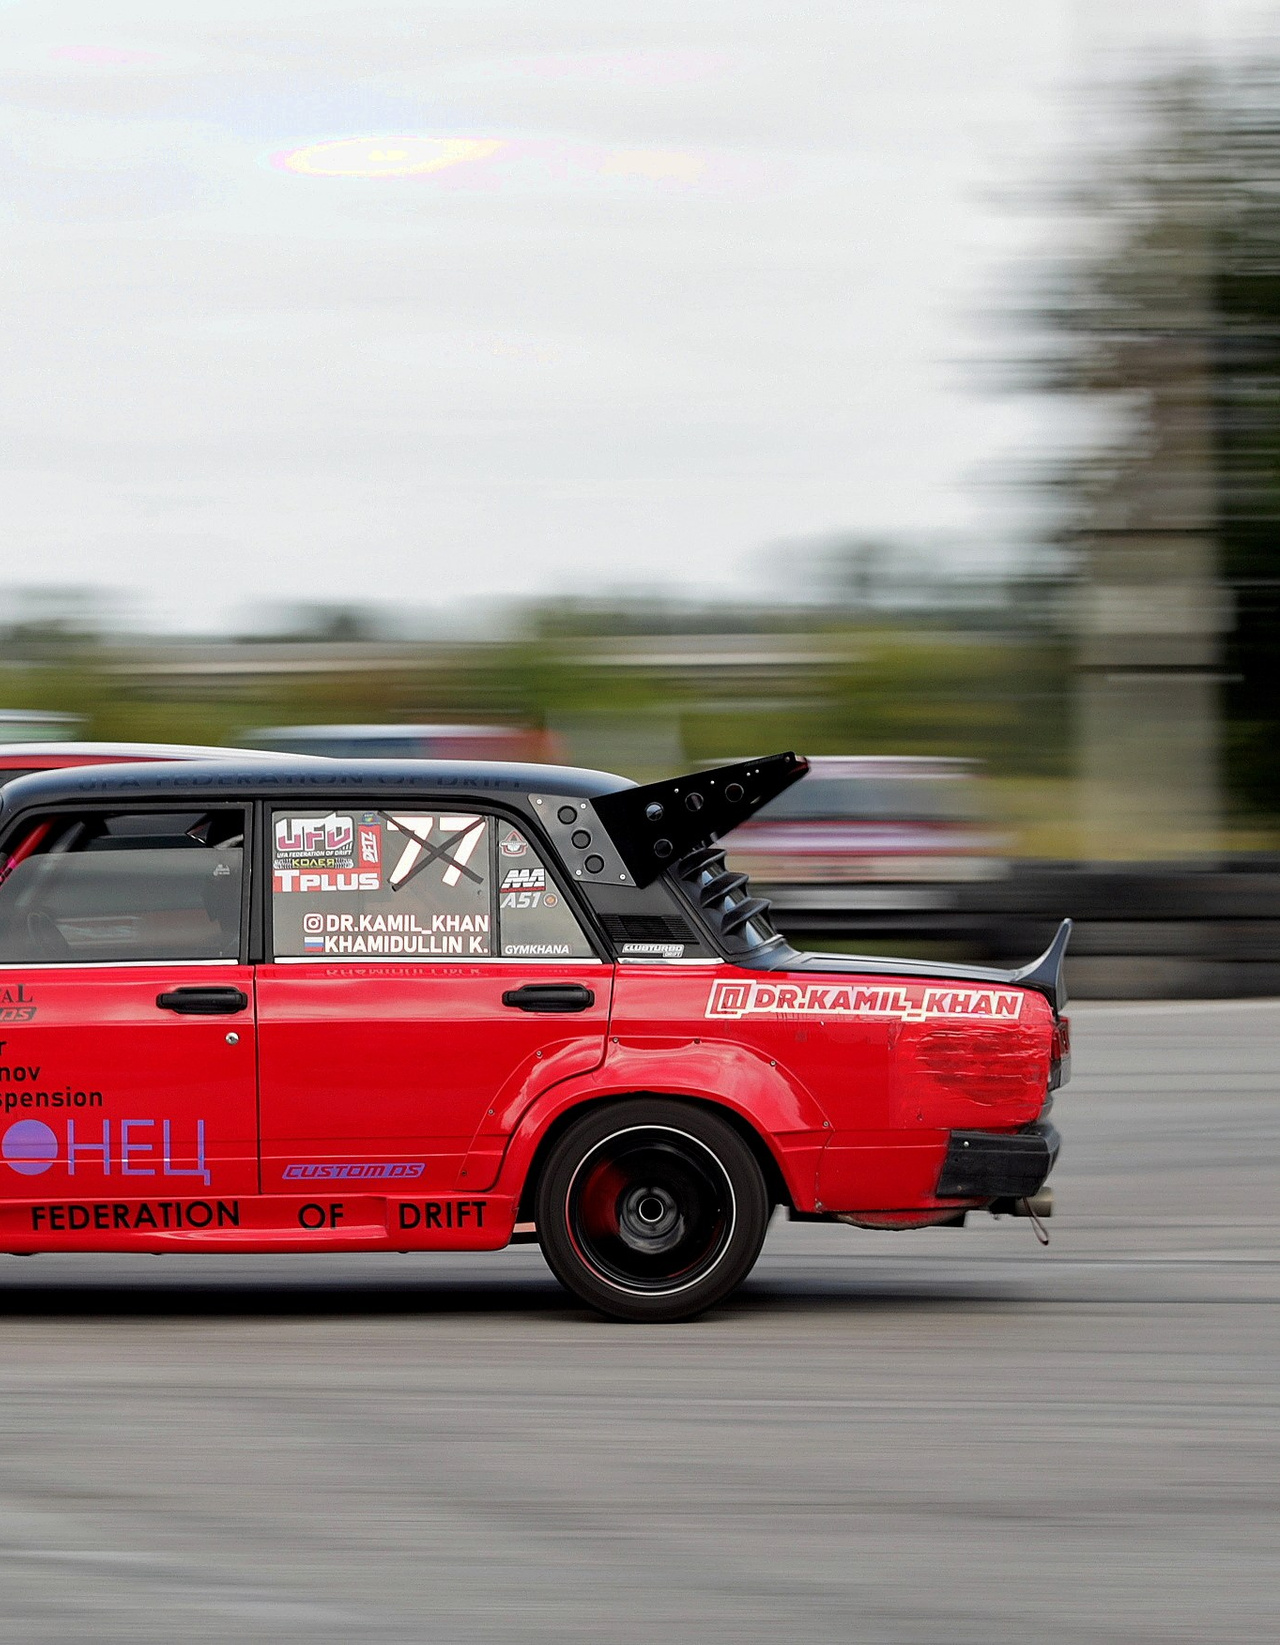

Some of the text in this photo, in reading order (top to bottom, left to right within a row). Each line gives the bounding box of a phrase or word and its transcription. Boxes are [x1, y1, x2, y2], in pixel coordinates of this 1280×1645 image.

[275, 812, 353, 851] UFD
[387, 816, 486, 887] 77
[500, 892, 541, 908] A51
[326, 914, 489, 934] DR.KAMIL_KHAN
[324, 935, 489, 953] KHAMIDULLIN K.
[505, 945, 569, 954] GYMKHANA
[31, 1200, 240, 1231] FEDERATION
[297, 1203, 344, 1230] OF
[399, 1201, 487, 1230] DRIFT
